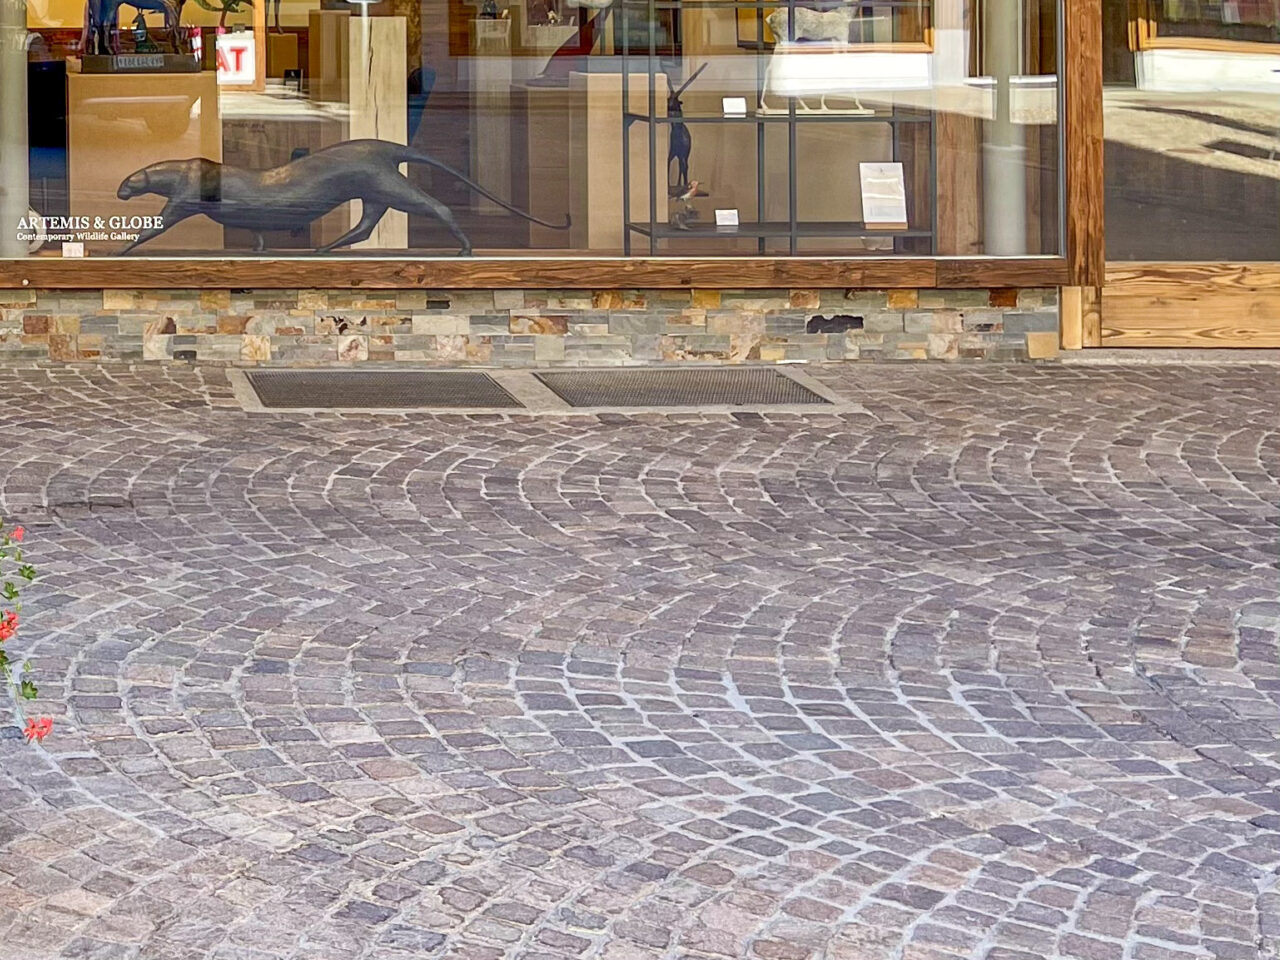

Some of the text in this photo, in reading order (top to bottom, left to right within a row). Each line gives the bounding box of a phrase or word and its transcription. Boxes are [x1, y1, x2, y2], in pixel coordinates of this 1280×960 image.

[16, 216, 164, 230] ARTEMIS & GLOBE
[16, 231, 140, 242] Contemporary Wildlife Gallery
